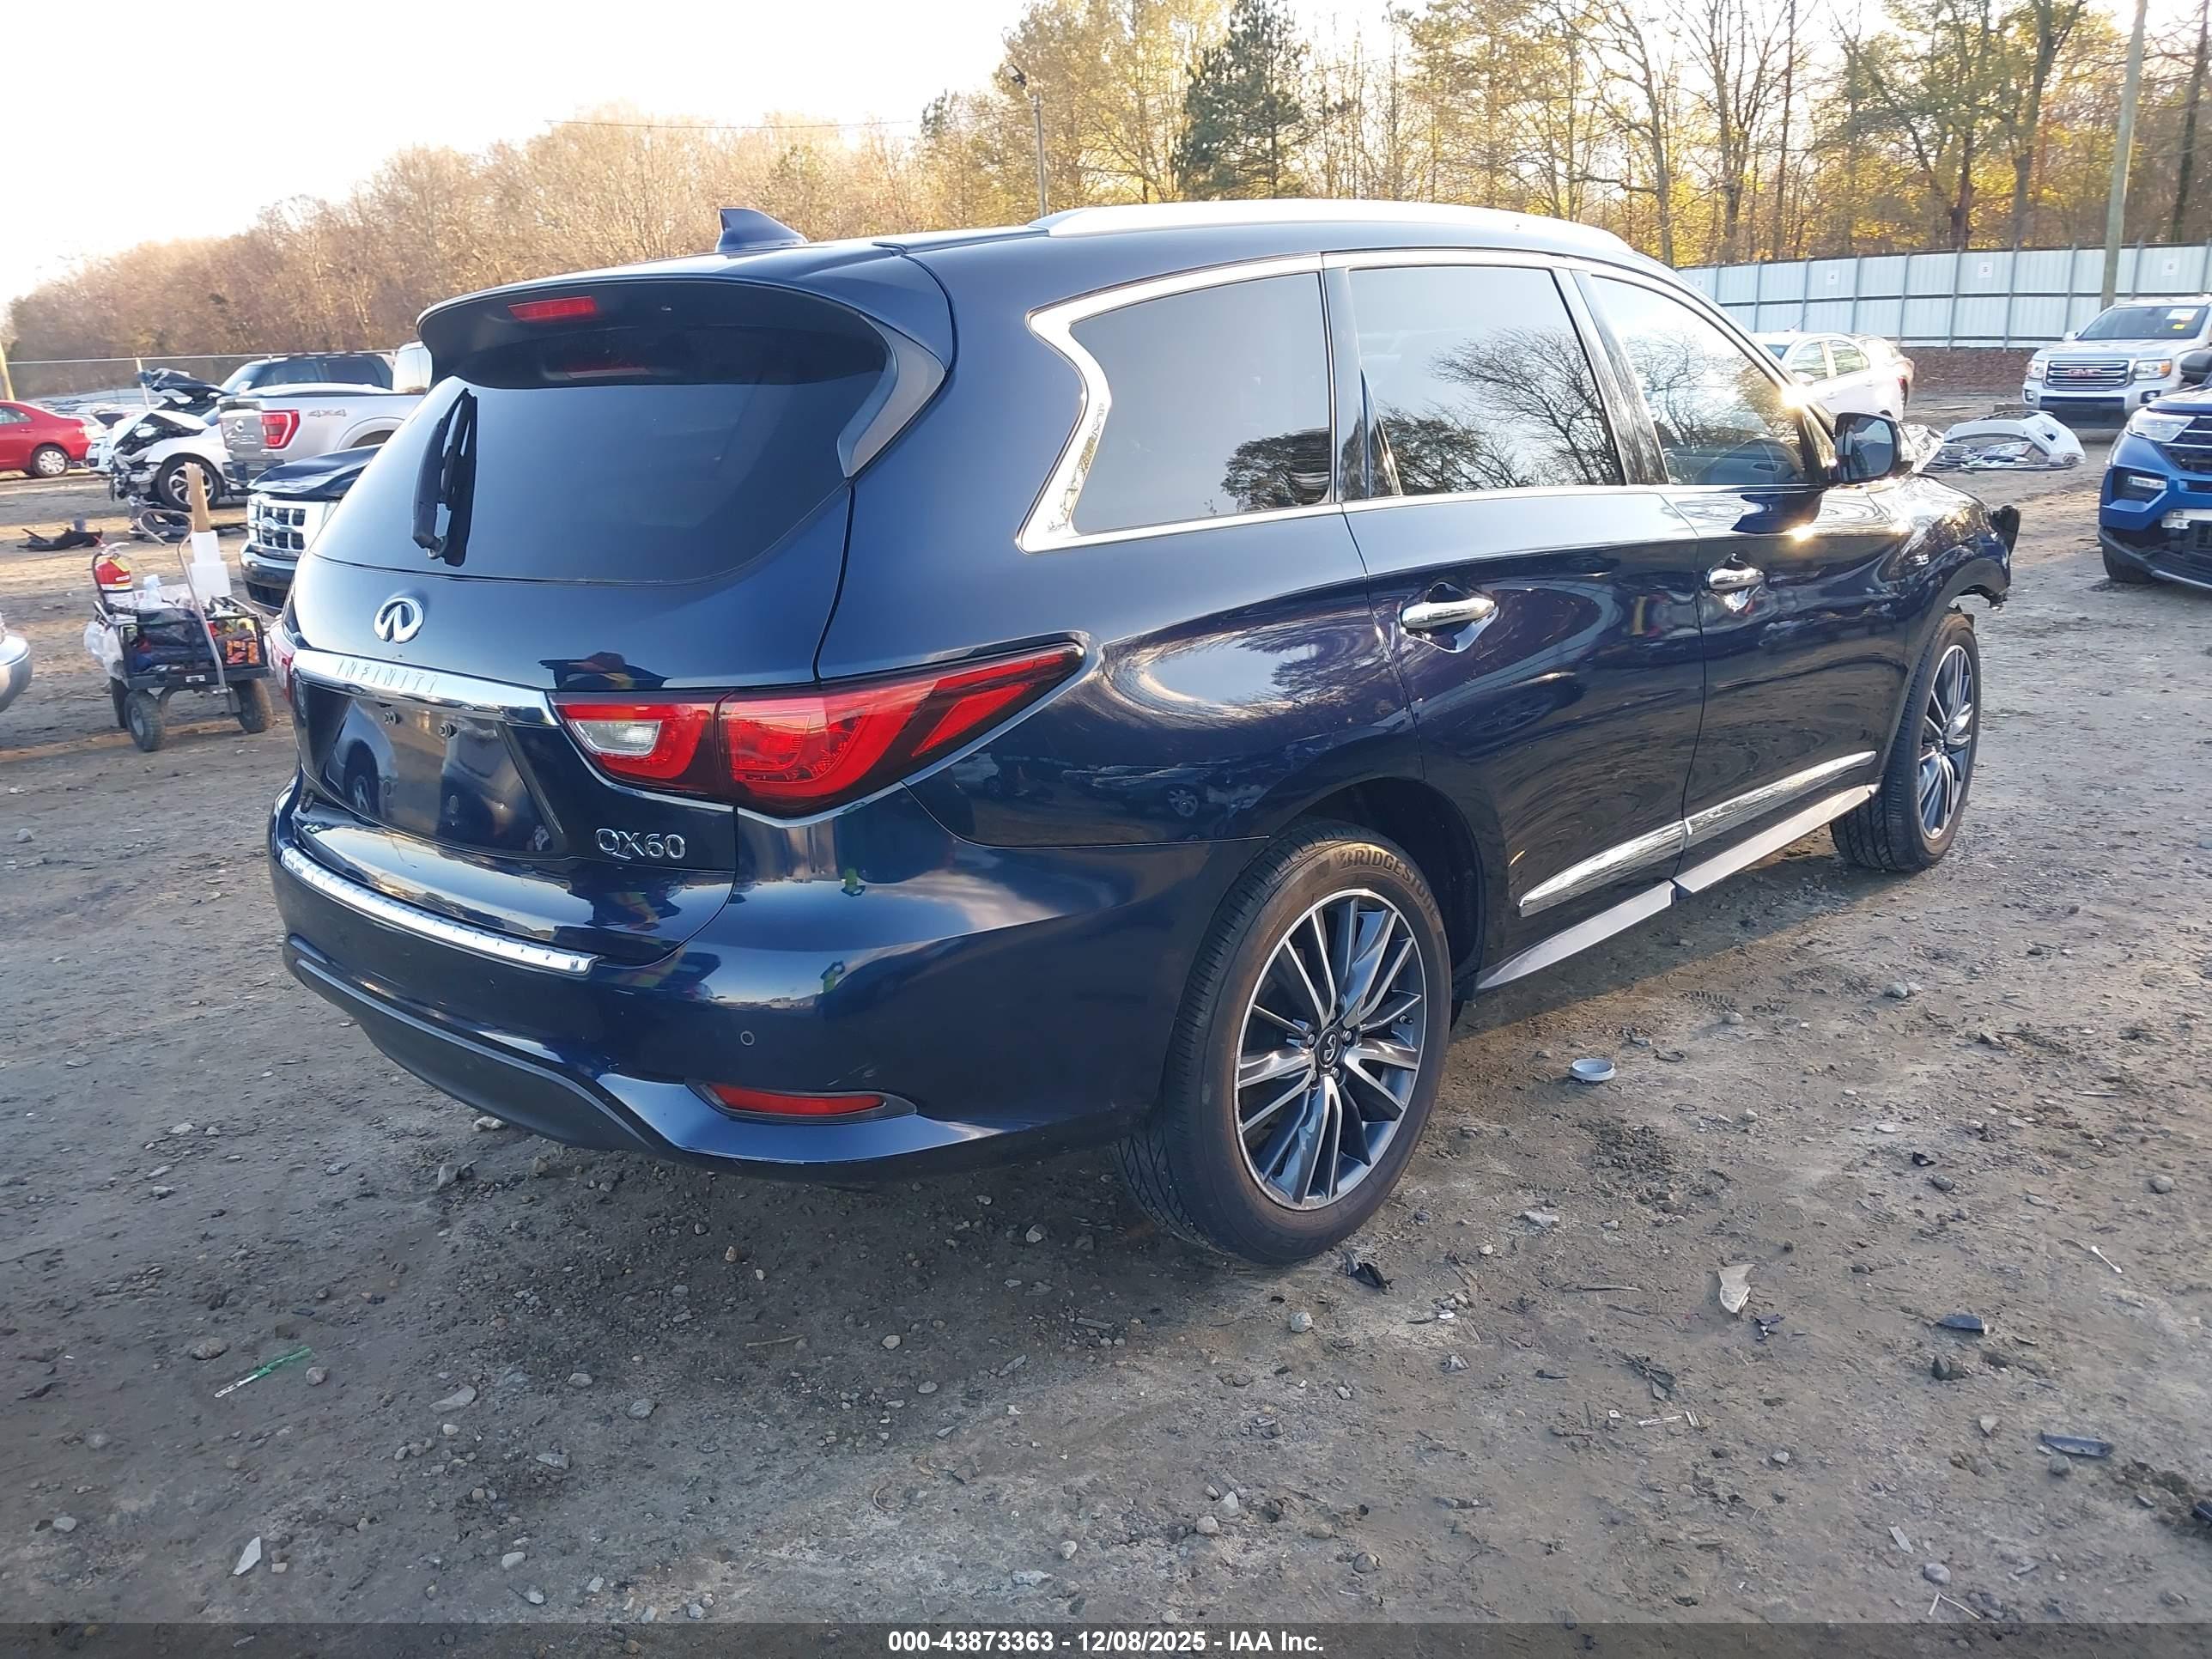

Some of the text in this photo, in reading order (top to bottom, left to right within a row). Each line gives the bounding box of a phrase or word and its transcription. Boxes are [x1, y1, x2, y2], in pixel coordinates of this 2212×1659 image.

[2067, 368, 2103, 378] GMC
[336, 658, 441, 694] INFINITI
[594, 827, 687, 861] QX60
[1334, 848, 1443, 923] BRIDGESTONE
